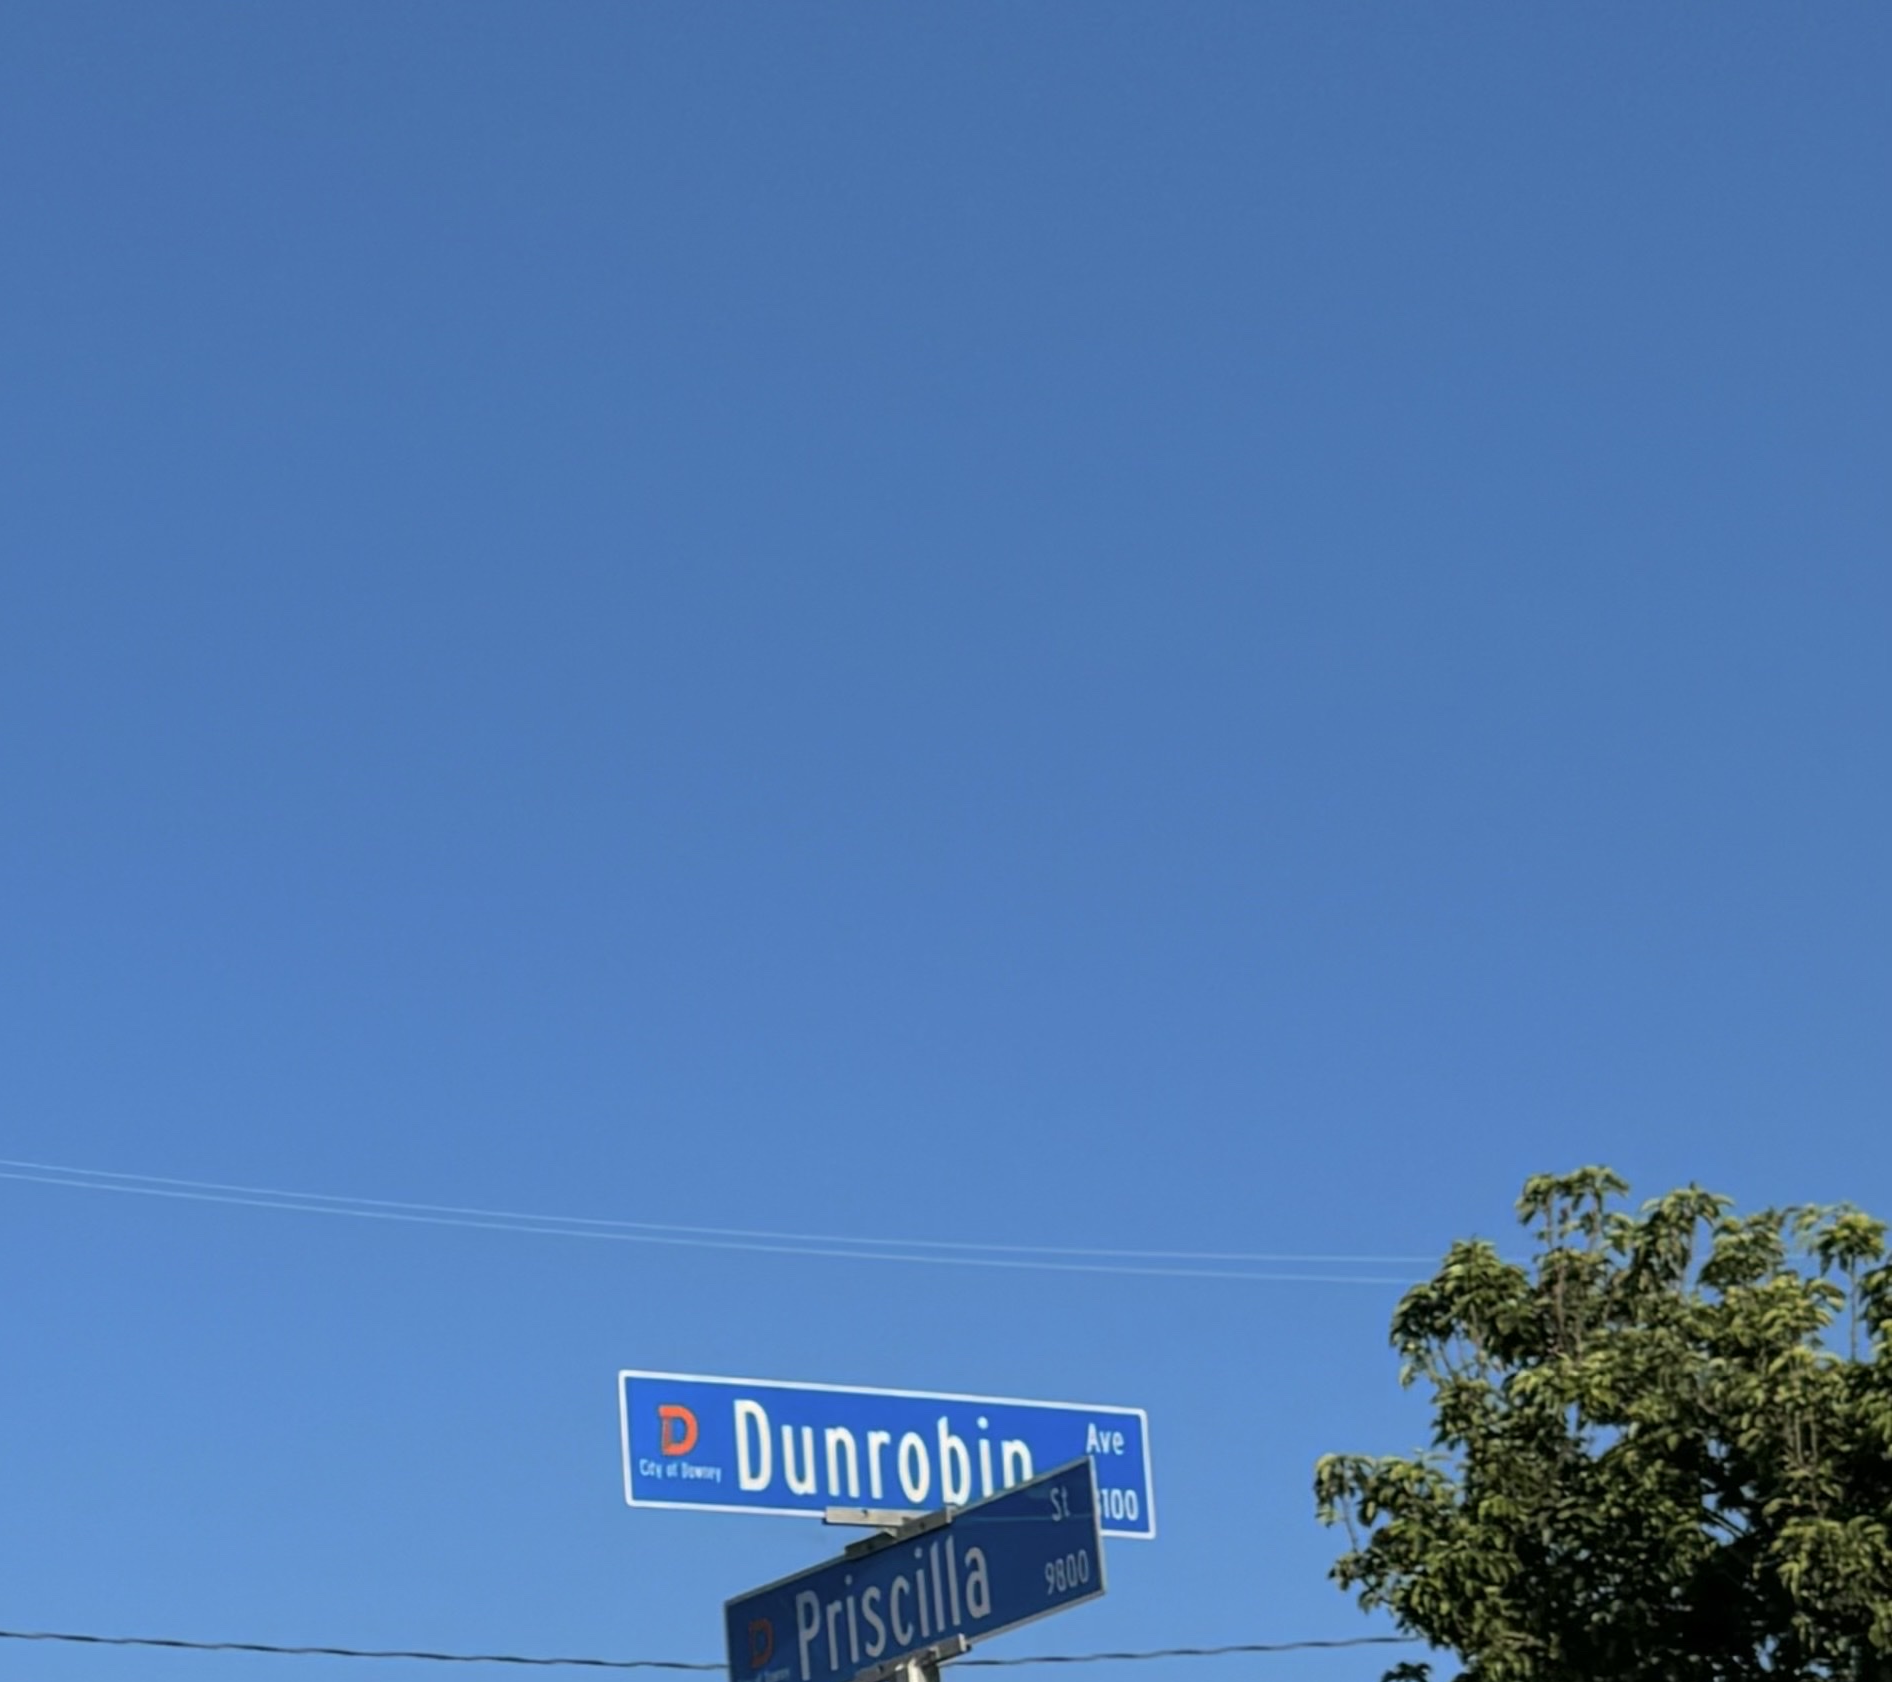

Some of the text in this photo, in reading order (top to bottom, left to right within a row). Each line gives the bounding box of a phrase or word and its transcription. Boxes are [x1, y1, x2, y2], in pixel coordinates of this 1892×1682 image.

[639, 1457, 662, 1479] City
[733, 1398, 1125, 1507] Dunrobin Ave
[1049, 1485, 1070, 1522] St
[1097, 1487, 1139, 1521] 100
[1044, 1548, 1090, 1596] 9800
[795, 1533, 992, 1682] Priscilla
